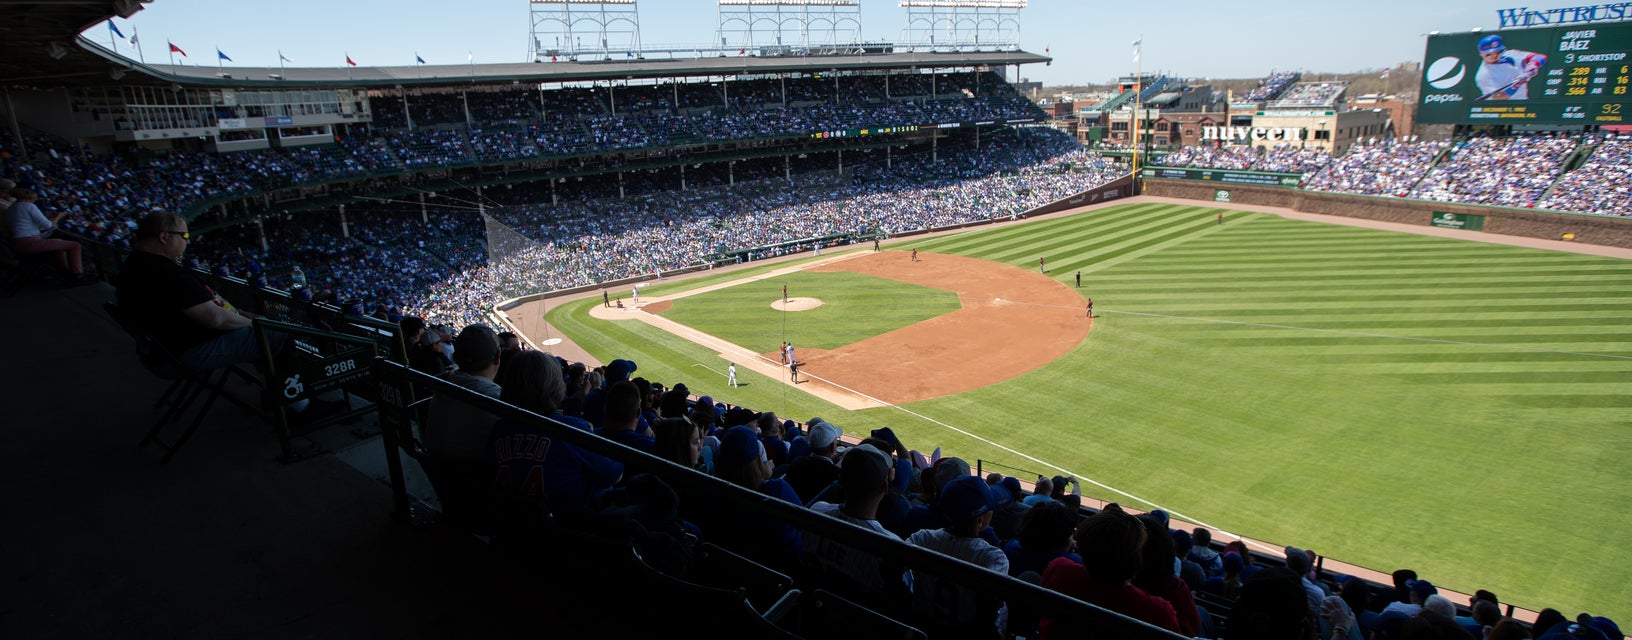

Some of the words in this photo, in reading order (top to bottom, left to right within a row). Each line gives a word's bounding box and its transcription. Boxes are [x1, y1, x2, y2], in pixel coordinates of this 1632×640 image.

[1561, 30, 1597, 40] JAVIER
[1559, 39, 1591, 51] BÁEZ
[1577, 53, 1626, 62] SHORTSTOP
[1620, 65, 1628, 74] 6
[1567, 76, 1588, 86] .314
[1616, 75, 1629, 85] 16
[1613, 85, 1627, 95] 83
[1424, 93, 1463, 104] pepsi
[1601, 103, 1622, 114] 92
[1202, 125, 1302, 141] nuveen
[325, 359, 356, 377] 328R
[496, 433, 552, 464] RIZZO
